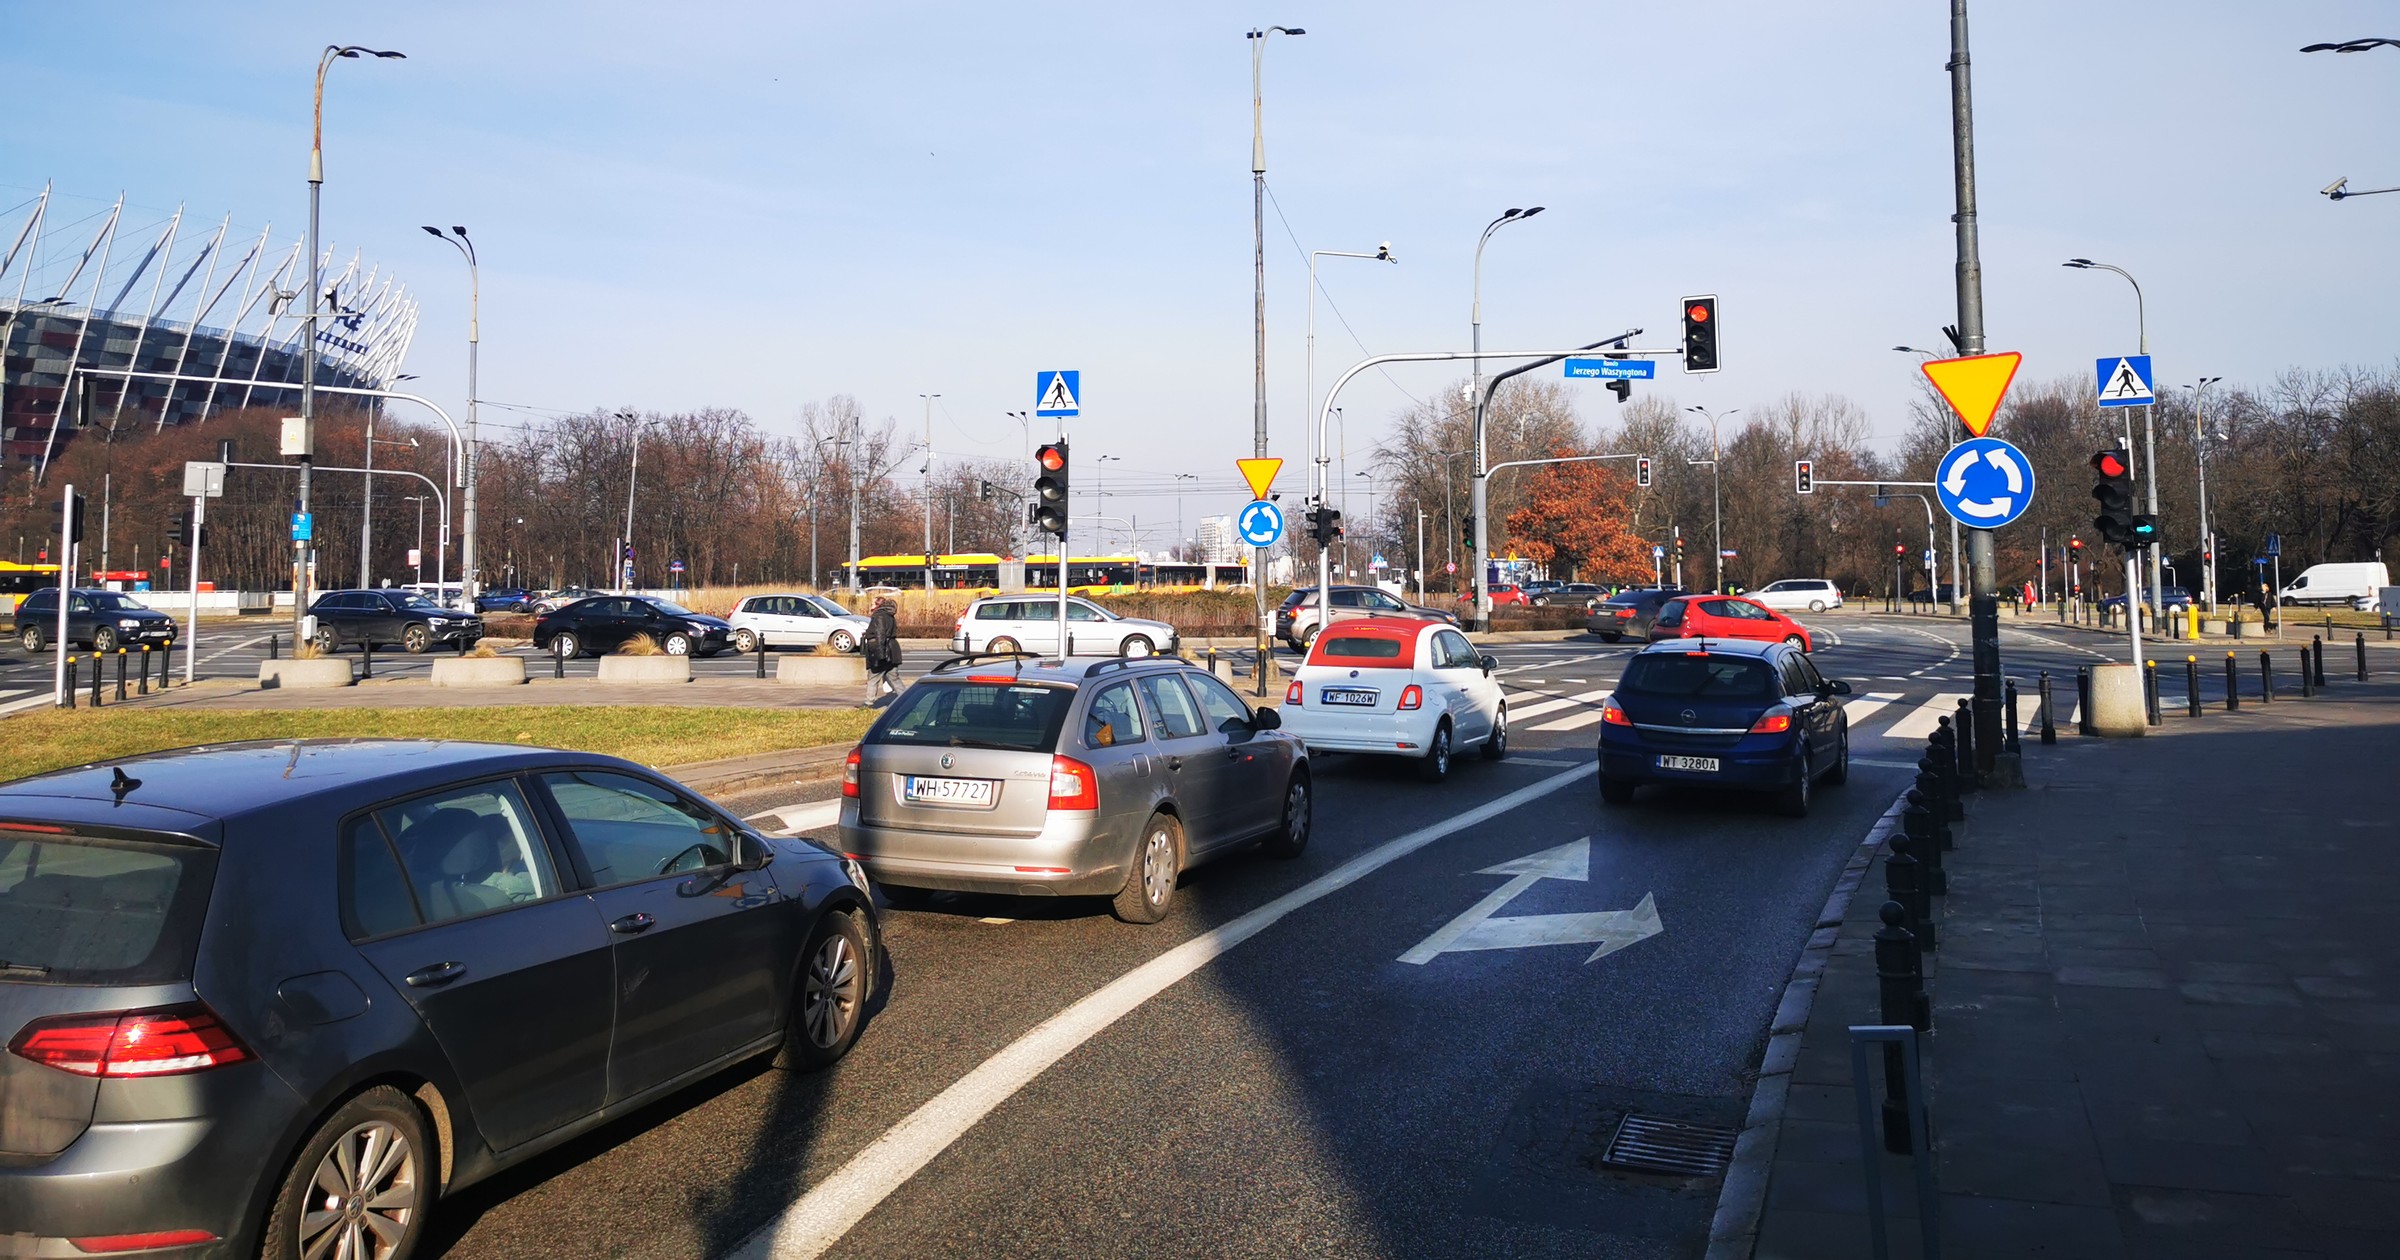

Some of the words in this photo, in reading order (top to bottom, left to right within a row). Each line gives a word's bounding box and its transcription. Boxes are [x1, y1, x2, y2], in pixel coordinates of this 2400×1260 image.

[1573, 367, 1600, 377] Jerzego
[1601, 367, 1647, 378] Waszyngtona
[1328, 692, 1342, 702] WF
[1345, 693, 1374, 704] 1026W
[1663, 756, 1678, 768] WT
[1681, 757, 1717, 770] 3280A
[916, 779, 938, 797] WH
[942, 781, 989, 799] 57727
